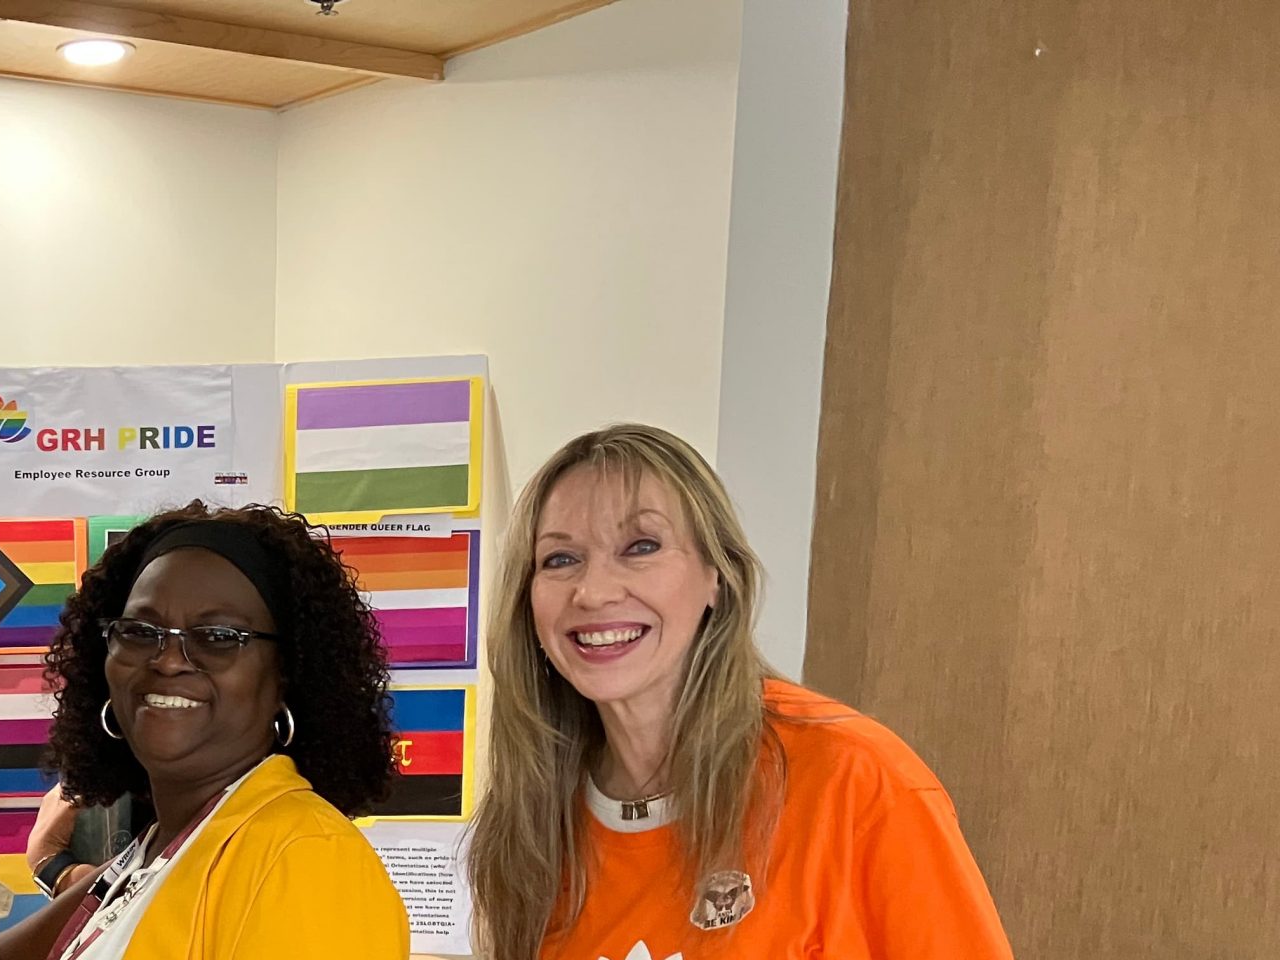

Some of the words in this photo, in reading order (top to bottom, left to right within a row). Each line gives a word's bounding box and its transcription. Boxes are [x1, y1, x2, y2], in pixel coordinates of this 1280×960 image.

[36, 428, 105, 452] GRH
[118, 425, 216, 451] PRIDE
[14, 469, 71, 481] Employee
[76, 468, 130, 479] Resource
[135, 467, 170, 480] Group
[330, 523, 368, 531] GENDER
[370, 524, 403, 532] QUEER
[406, 524, 431, 532] FLAG
[720, 914, 737, 926] KIN
